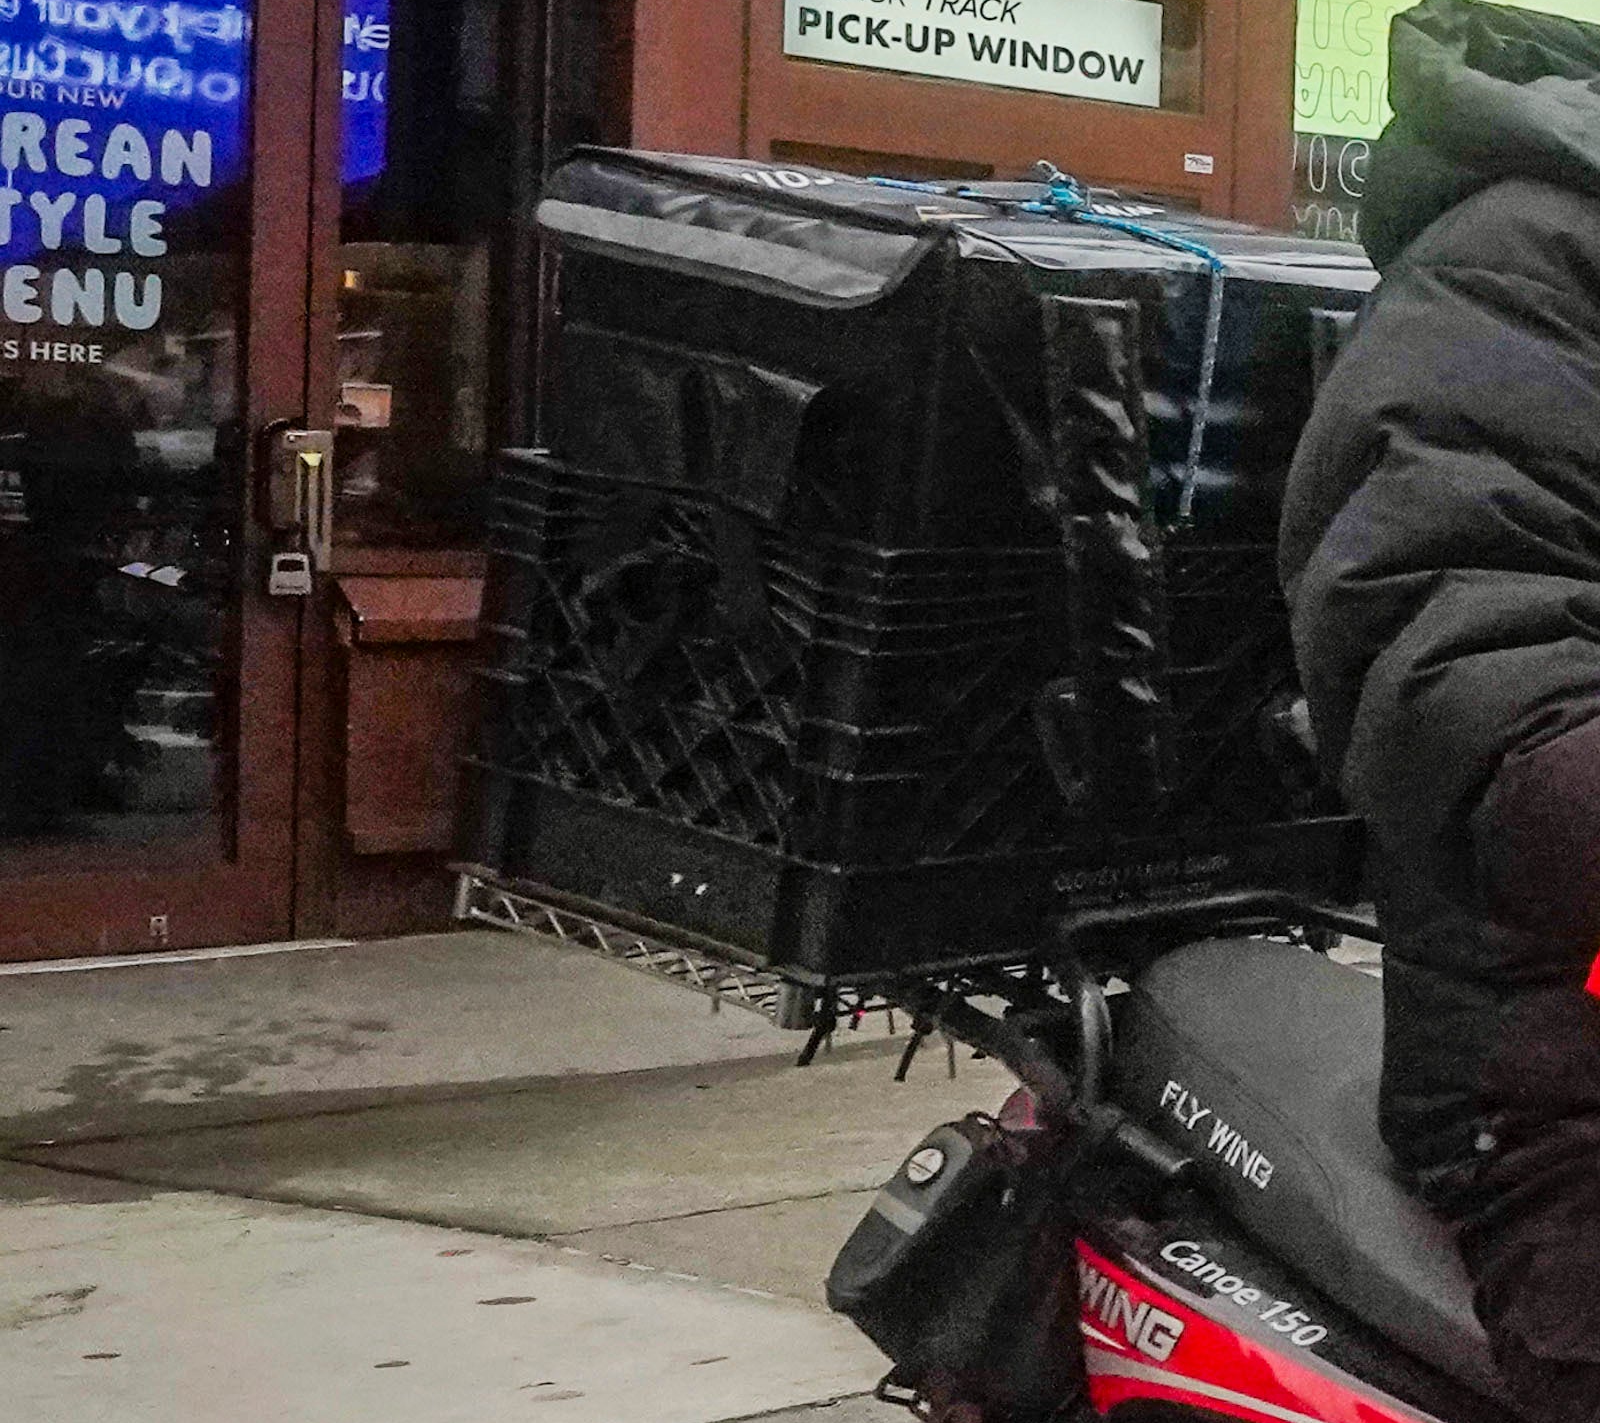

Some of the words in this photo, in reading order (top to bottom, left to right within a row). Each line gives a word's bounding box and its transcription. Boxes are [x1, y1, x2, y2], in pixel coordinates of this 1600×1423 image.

[799, 6, 956, 57] PICK-UP
[967, 33, 1145, 85] WINDOW
[57, 88, 128, 110] NEW
[1, 111, 213, 188] REAN
[3, 264, 163, 331] ENU
[30, 341, 103, 365] HERE
[1159, 1080, 1212, 1130] FLY
[1207, 1118, 1274, 1189] WING
[1079, 1257, 1185, 1362] WING
[1159, 1240, 1262, 1306] Canoe
[1258, 1300, 1328, 1347] 150
